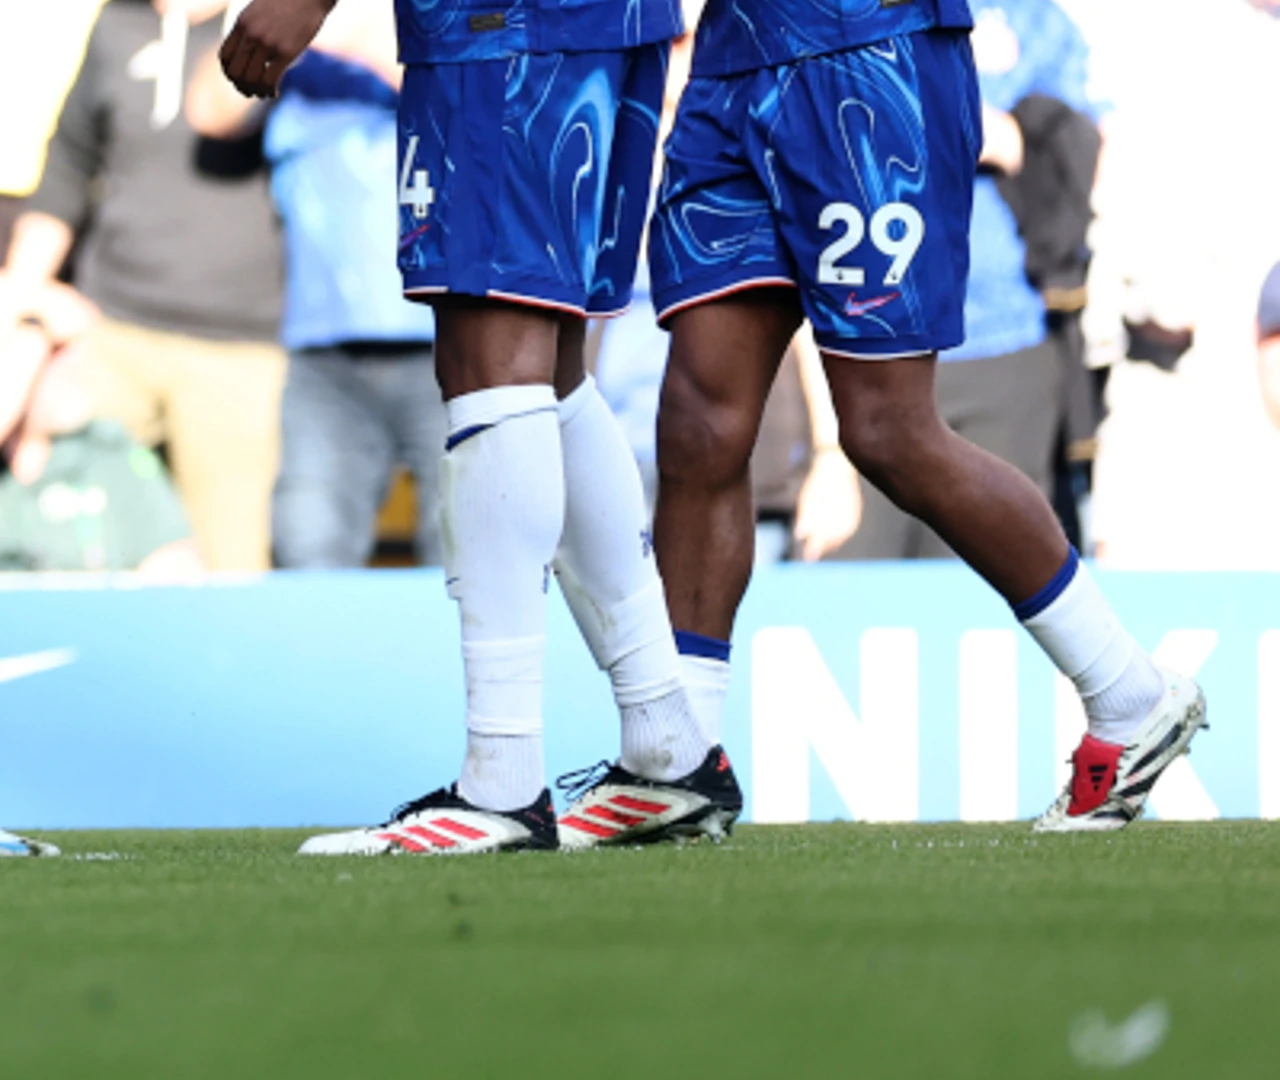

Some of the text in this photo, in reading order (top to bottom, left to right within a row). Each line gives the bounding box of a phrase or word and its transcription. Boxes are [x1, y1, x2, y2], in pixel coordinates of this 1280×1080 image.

[398, 135, 435, 219] 4
[818, 202, 925, 286] 29
[751, 625, 1280, 824] NIK
